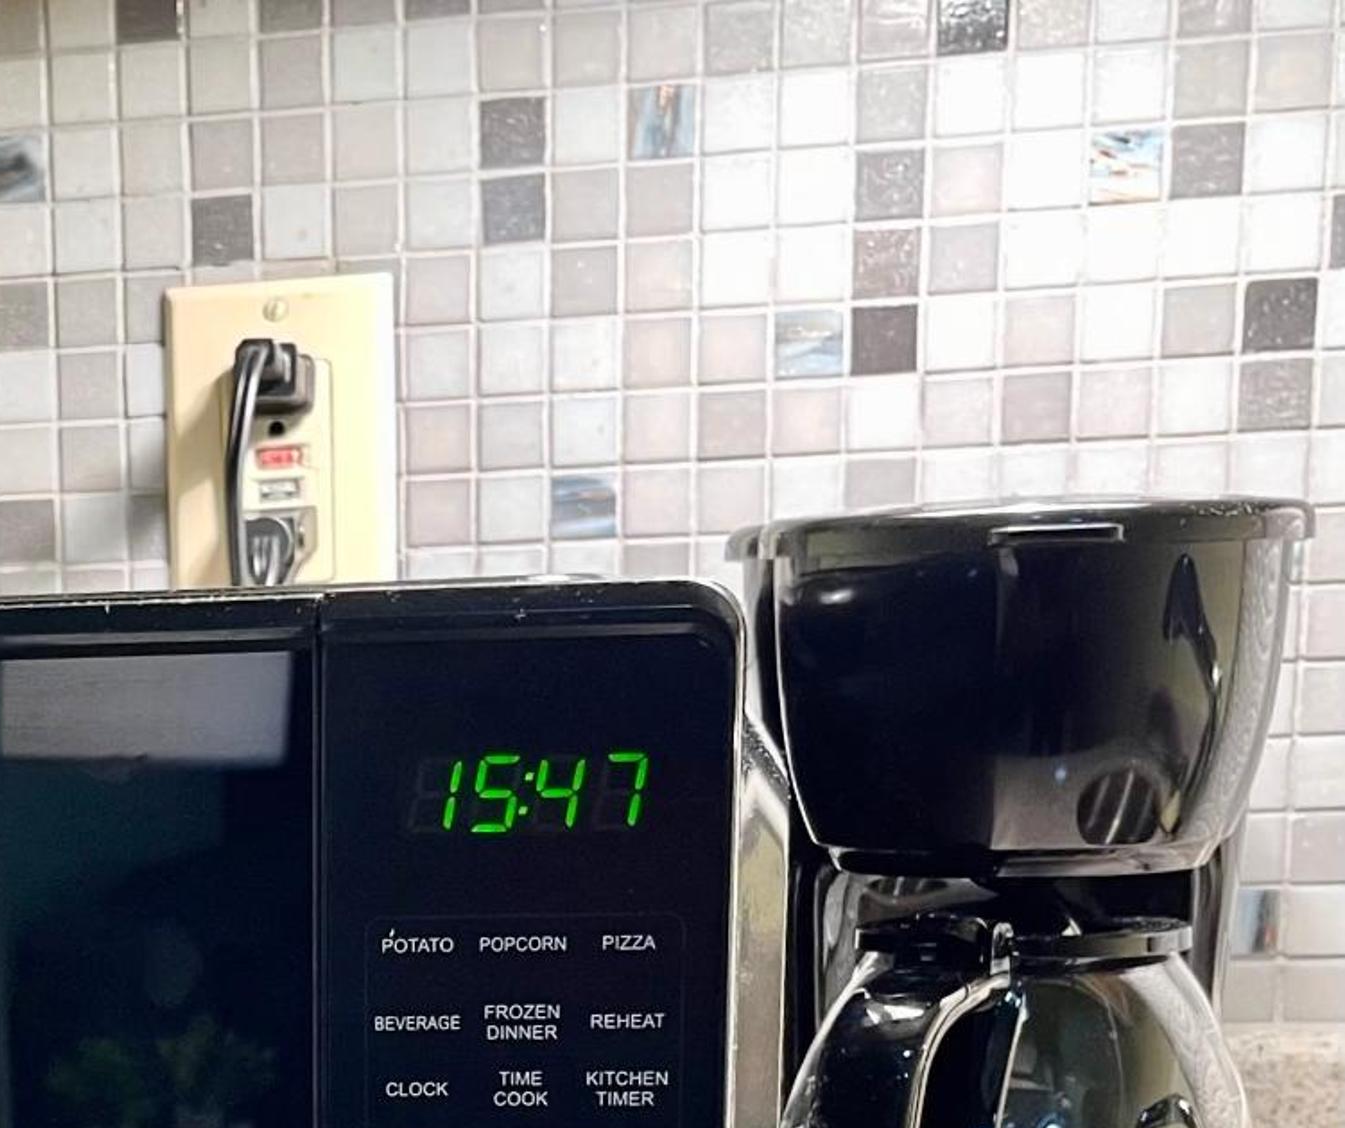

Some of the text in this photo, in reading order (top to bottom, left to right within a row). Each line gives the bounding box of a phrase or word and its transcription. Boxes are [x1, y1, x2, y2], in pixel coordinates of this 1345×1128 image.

[442, 752, 649, 833] 15:47
[381, 935, 455, 954] POTATO
[479, 935, 567, 953] POPCORN
[602, 934, 656, 951] PIZZA
[484, 1003, 561, 1020] FROZEN
[374, 1014, 461, 1032] BEVERAGE
[590, 1012, 665, 1030] REHEAT
[486, 1024, 558, 1041] DINNER
[498, 1070, 543, 1087] TIME
[585, 1070, 669, 1087] KITCHEN
[385, 1081, 449, 1098] CLOCK
[492, 1090, 548, 1107] COOK
[595, 1090, 655, 1107] TIMER
